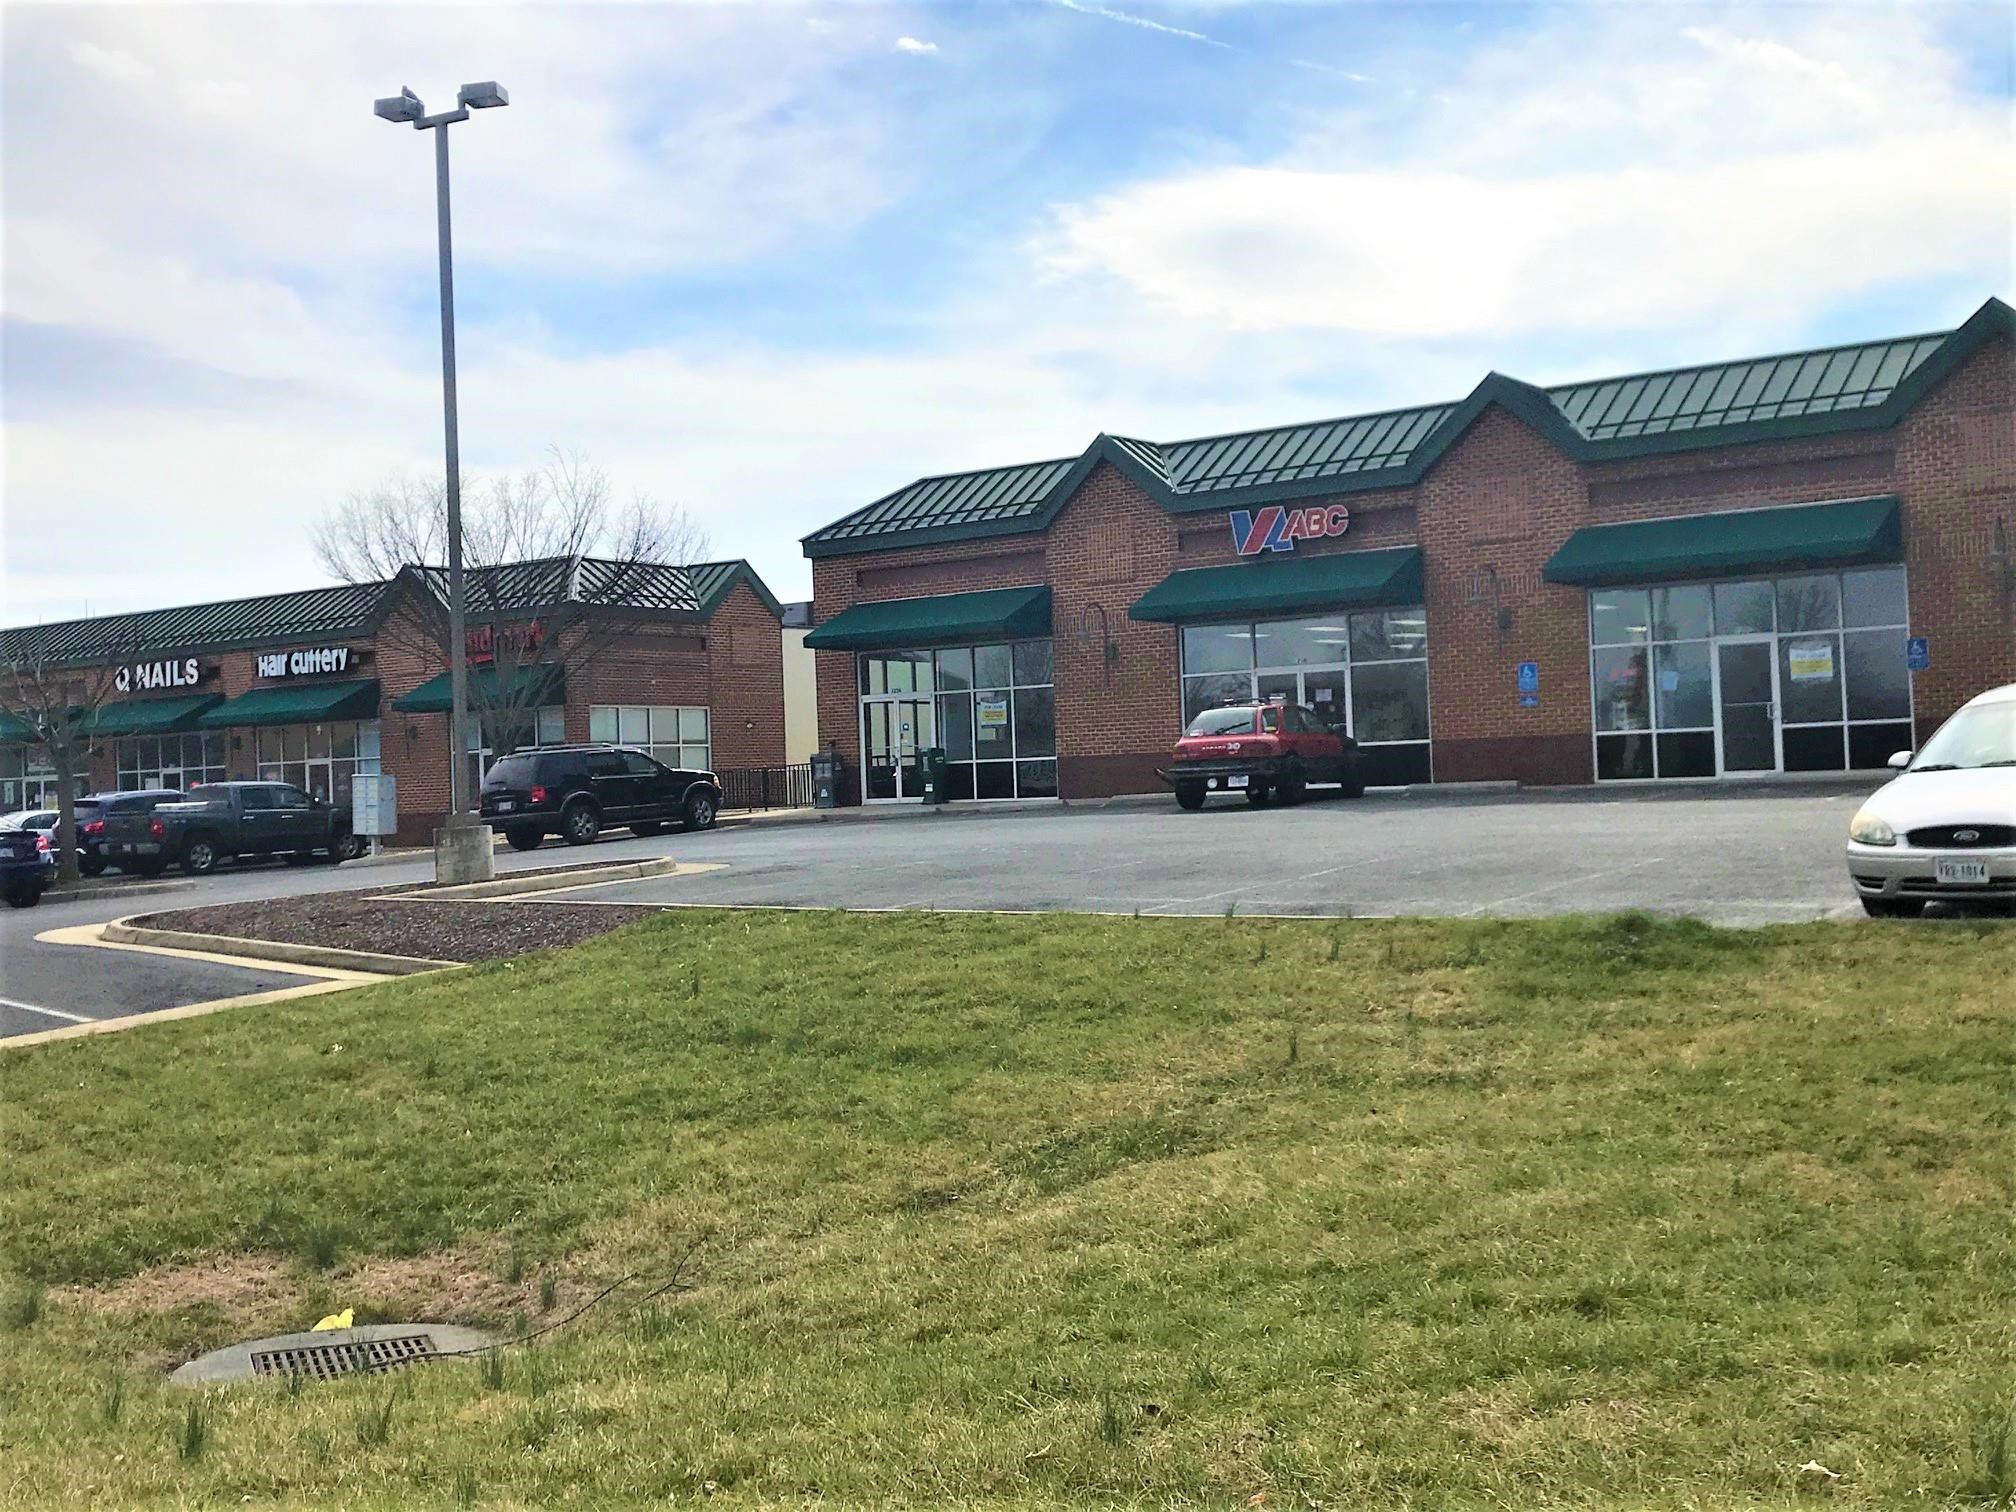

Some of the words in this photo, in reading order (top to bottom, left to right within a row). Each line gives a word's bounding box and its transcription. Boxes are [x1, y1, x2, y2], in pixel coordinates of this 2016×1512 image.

[1279, 504, 1349, 541] ABC
[115, 666, 131, 691] Q
[136, 658, 199, 690] NAILS
[258, 653, 288, 678] Hair
